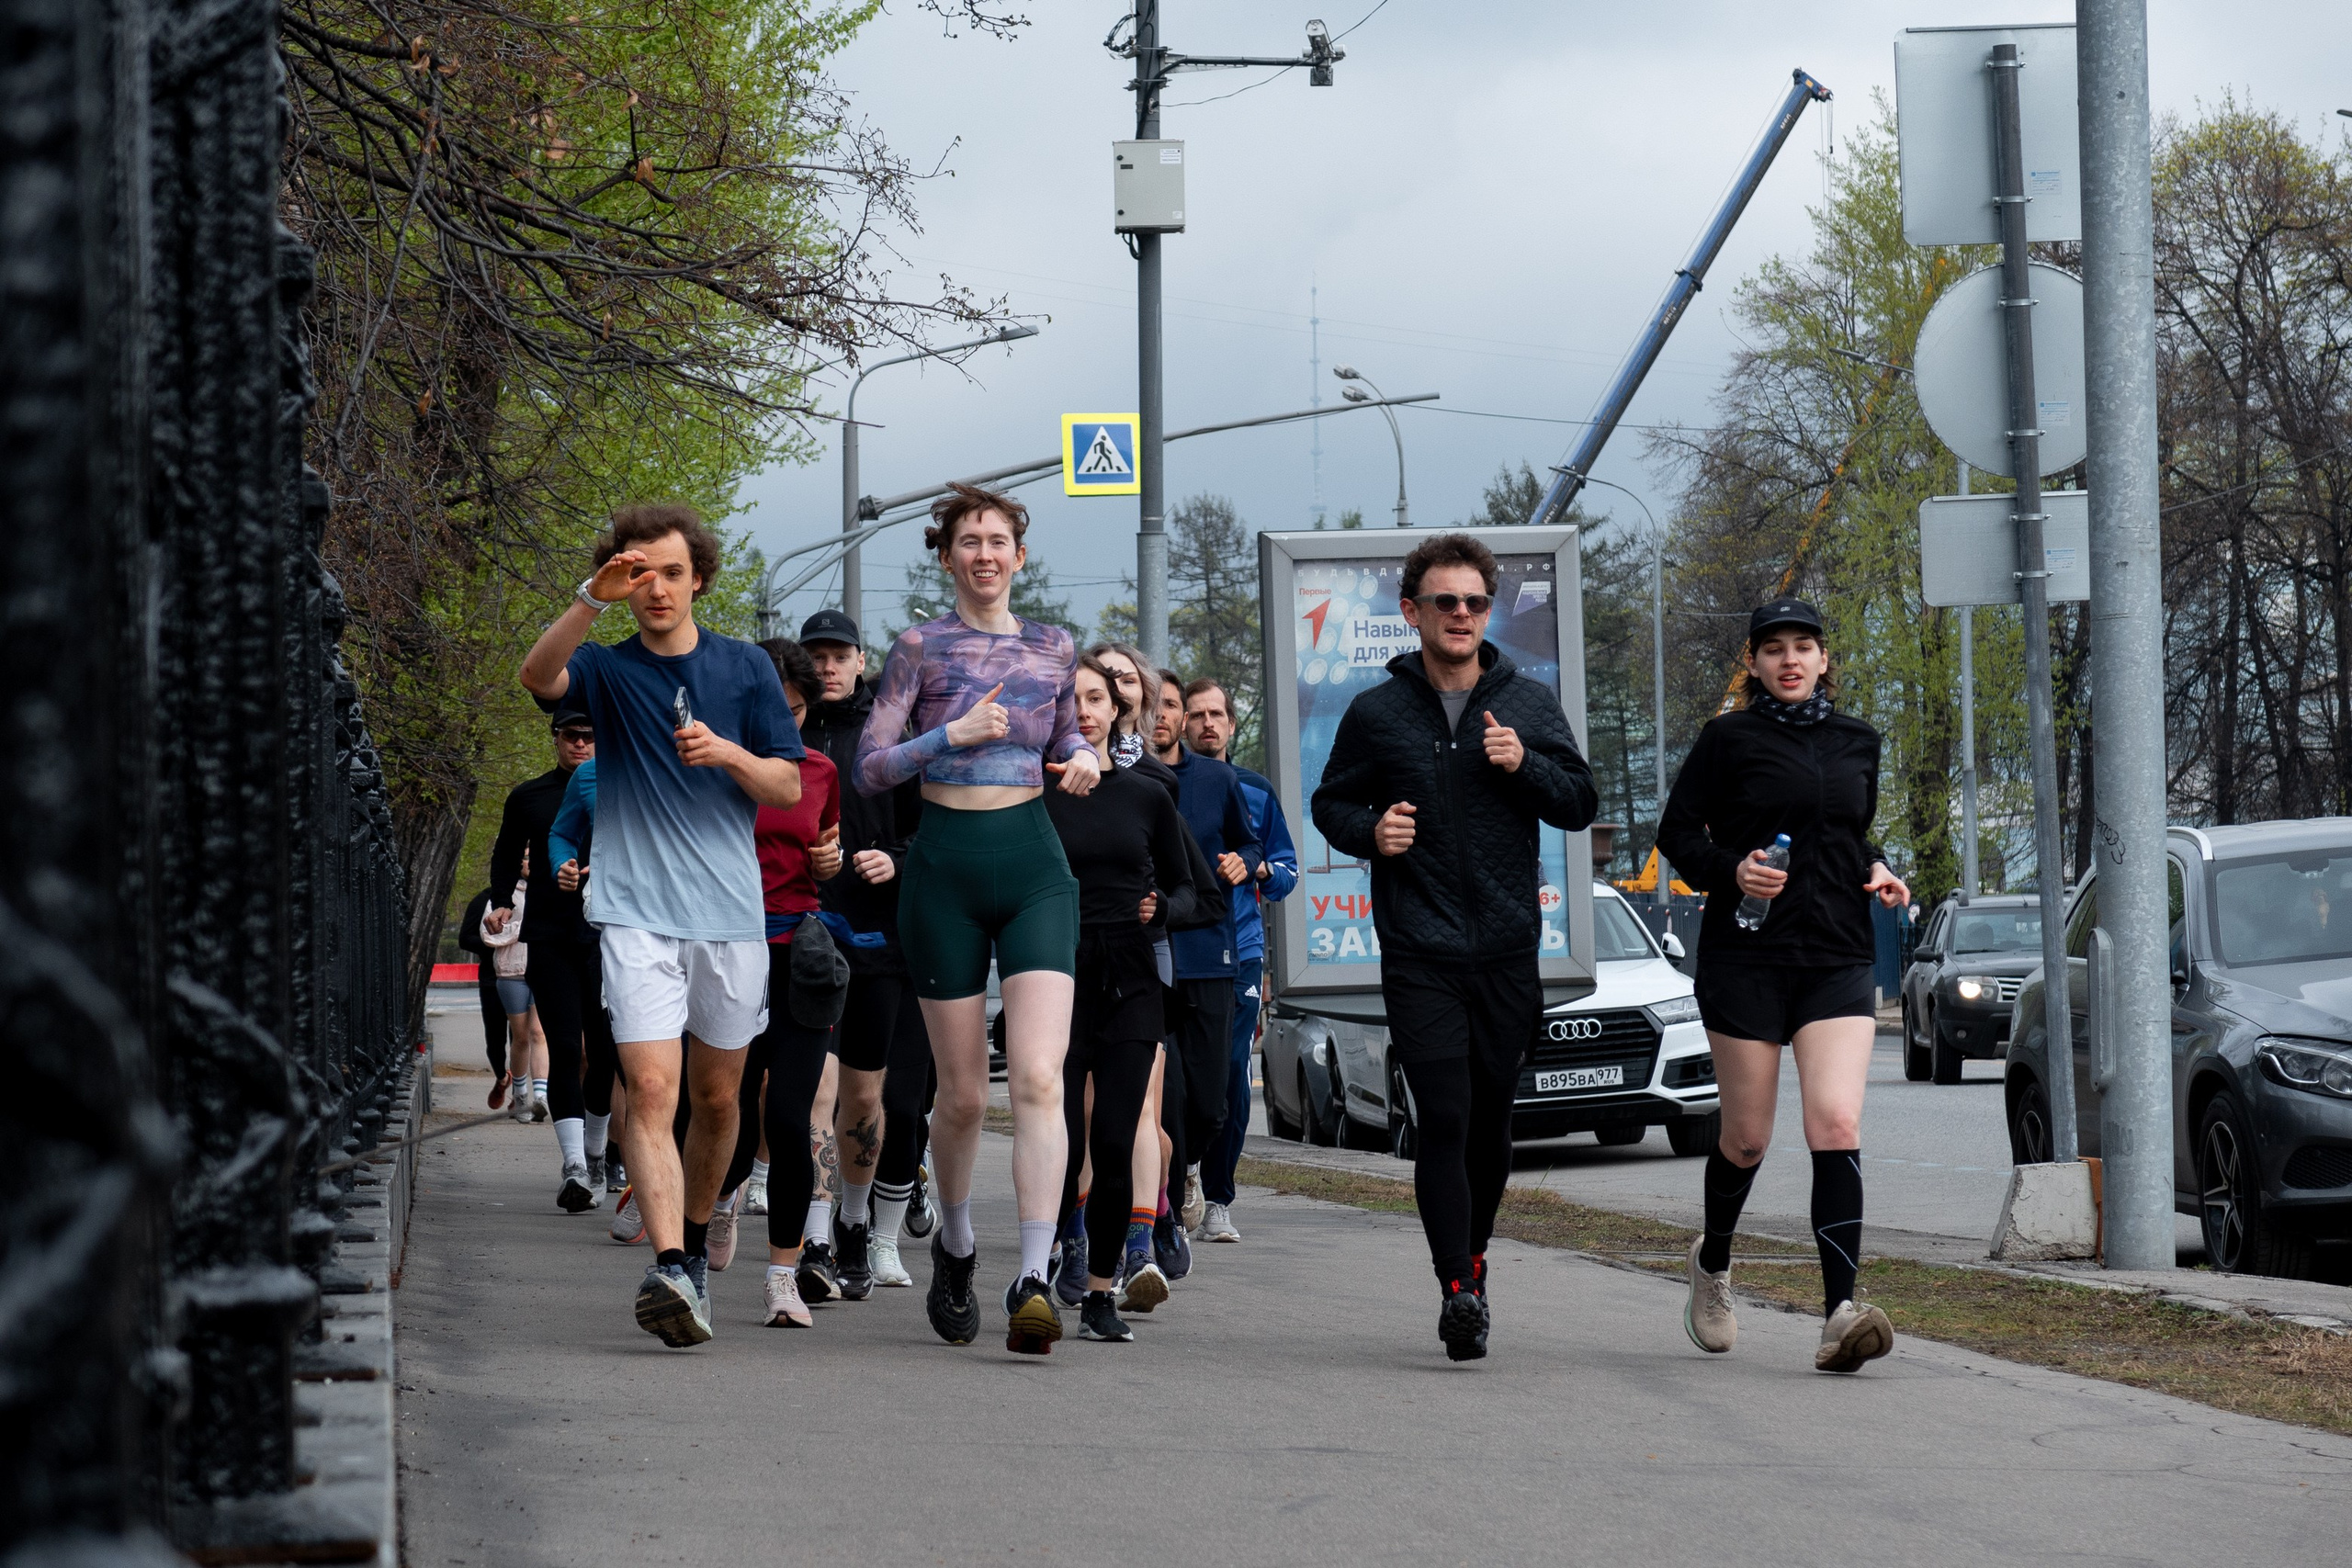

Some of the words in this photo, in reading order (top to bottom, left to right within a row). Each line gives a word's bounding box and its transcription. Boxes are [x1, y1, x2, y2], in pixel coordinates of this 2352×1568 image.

[1299, 588, 1331, 597] Первые
[1353, 620, 1421, 637] Навык
[1353, 646, 1389, 663] для
[1539, 892, 1561, 906] 6+
[1310, 894, 1373, 920] УЧИ
[1597, 1067, 1619, 1080] 977
